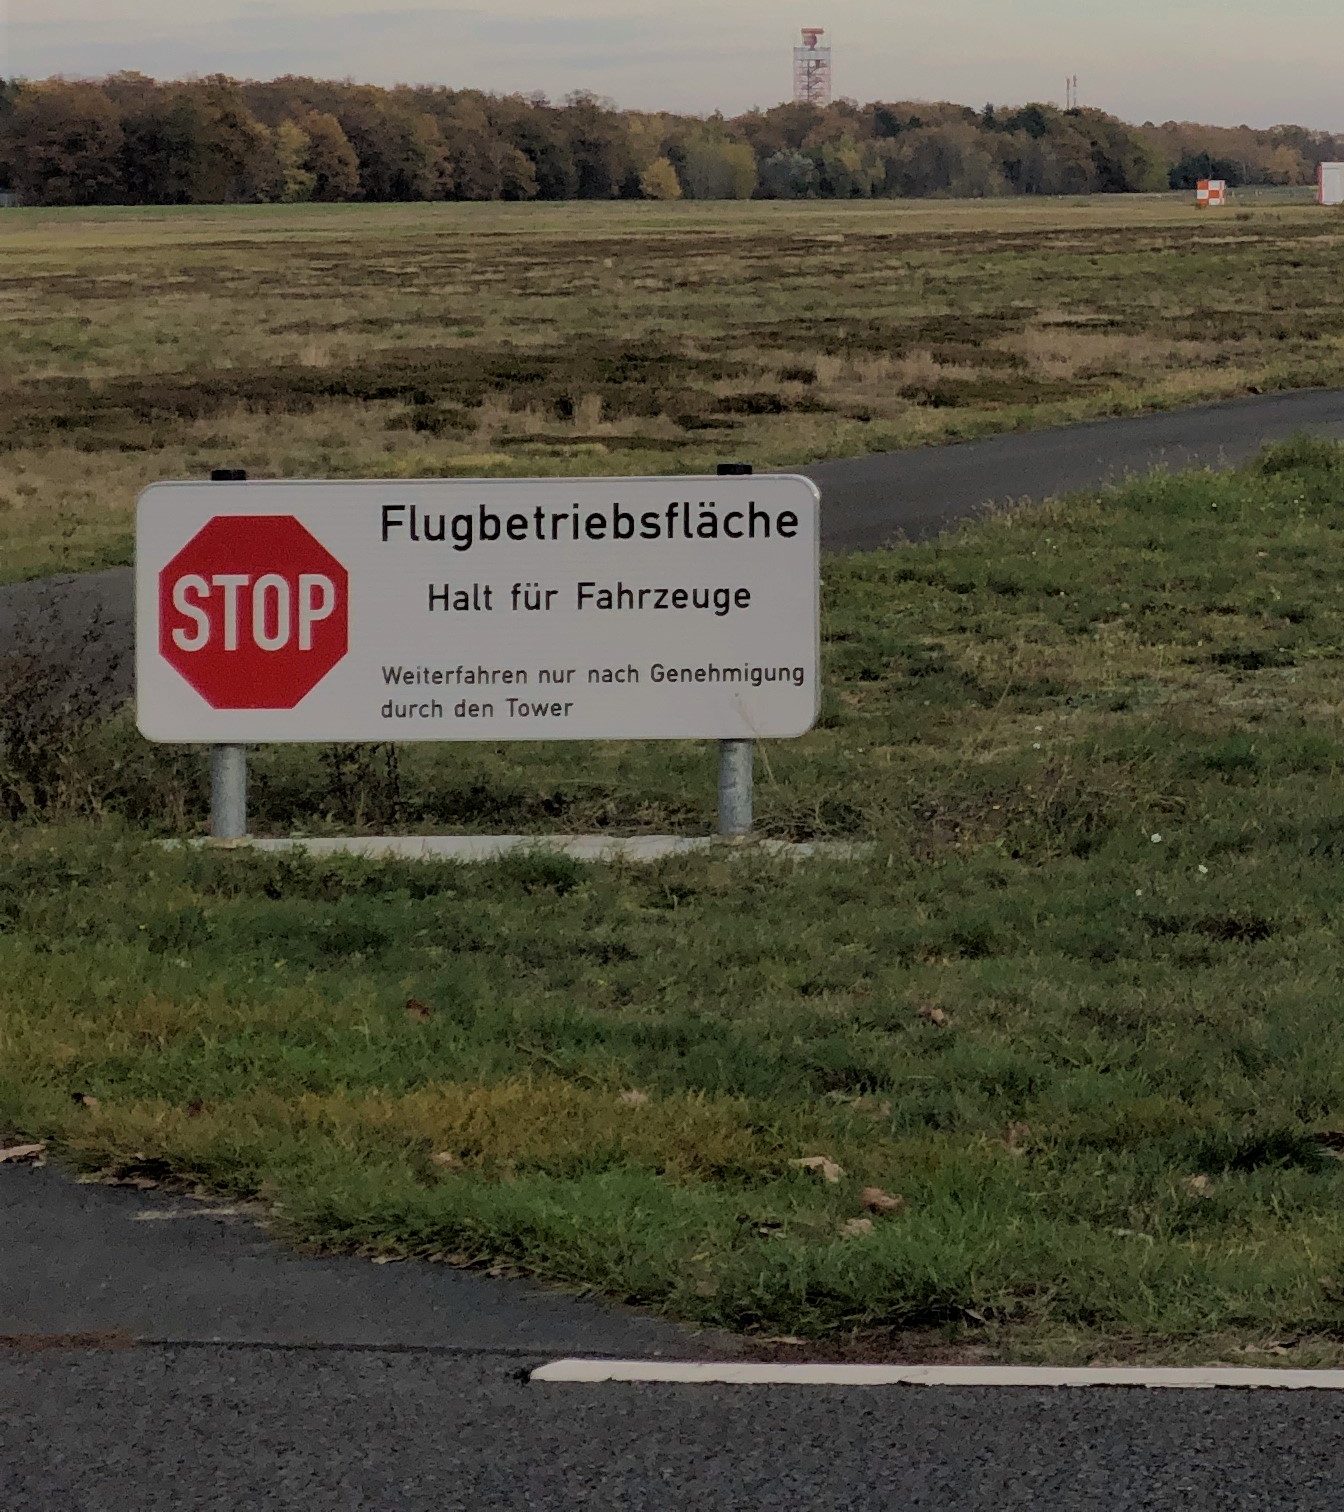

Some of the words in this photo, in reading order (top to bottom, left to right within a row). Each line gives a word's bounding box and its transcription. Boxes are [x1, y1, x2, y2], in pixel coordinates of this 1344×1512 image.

[381, 500, 799, 552] Flugbetriebsfläche
[171, 573, 337, 652] STOP
[428, 582, 493, 612] Halt
[511, 582, 559, 611] für
[577, 581, 752, 617] Fahrzeuge
[381, 664, 528, 686] Weiterfahren
[538, 669, 577, 684] nur
[588, 663, 640, 684] nach
[650, 662, 805, 688] Genehmigung
[381, 698, 443, 719] durch
[454, 698, 494, 718] den
[505, 697, 574, 718] Tower
